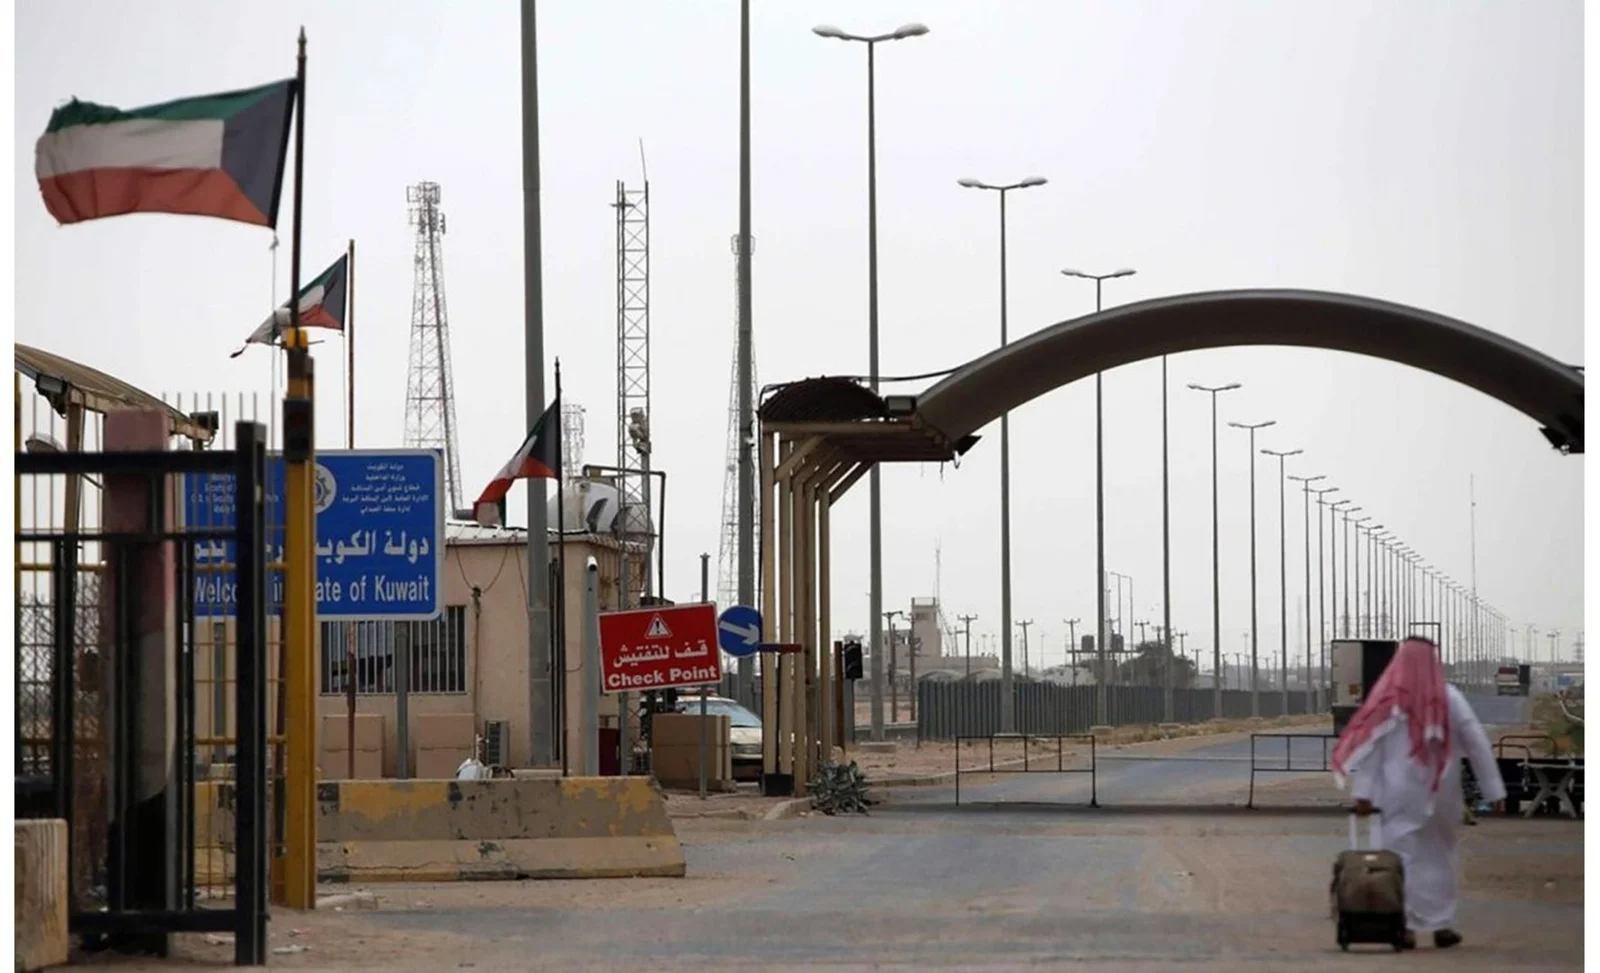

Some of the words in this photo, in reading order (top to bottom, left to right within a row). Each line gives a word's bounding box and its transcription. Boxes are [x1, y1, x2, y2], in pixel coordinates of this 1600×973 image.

[315, 529, 377, 565] الكوي
[383, 529, 430, 564] دولة
[194, 575, 237, 603] Welco
[315, 576, 342, 602] ate
[349, 574, 367, 602] of
[374, 574, 430, 602] Kuwait
[613, 643, 670, 668] للتفتيش
[674, 640, 709, 658] قف
[608, 669, 664, 687] Check
[669, 665, 717, 682] Point
